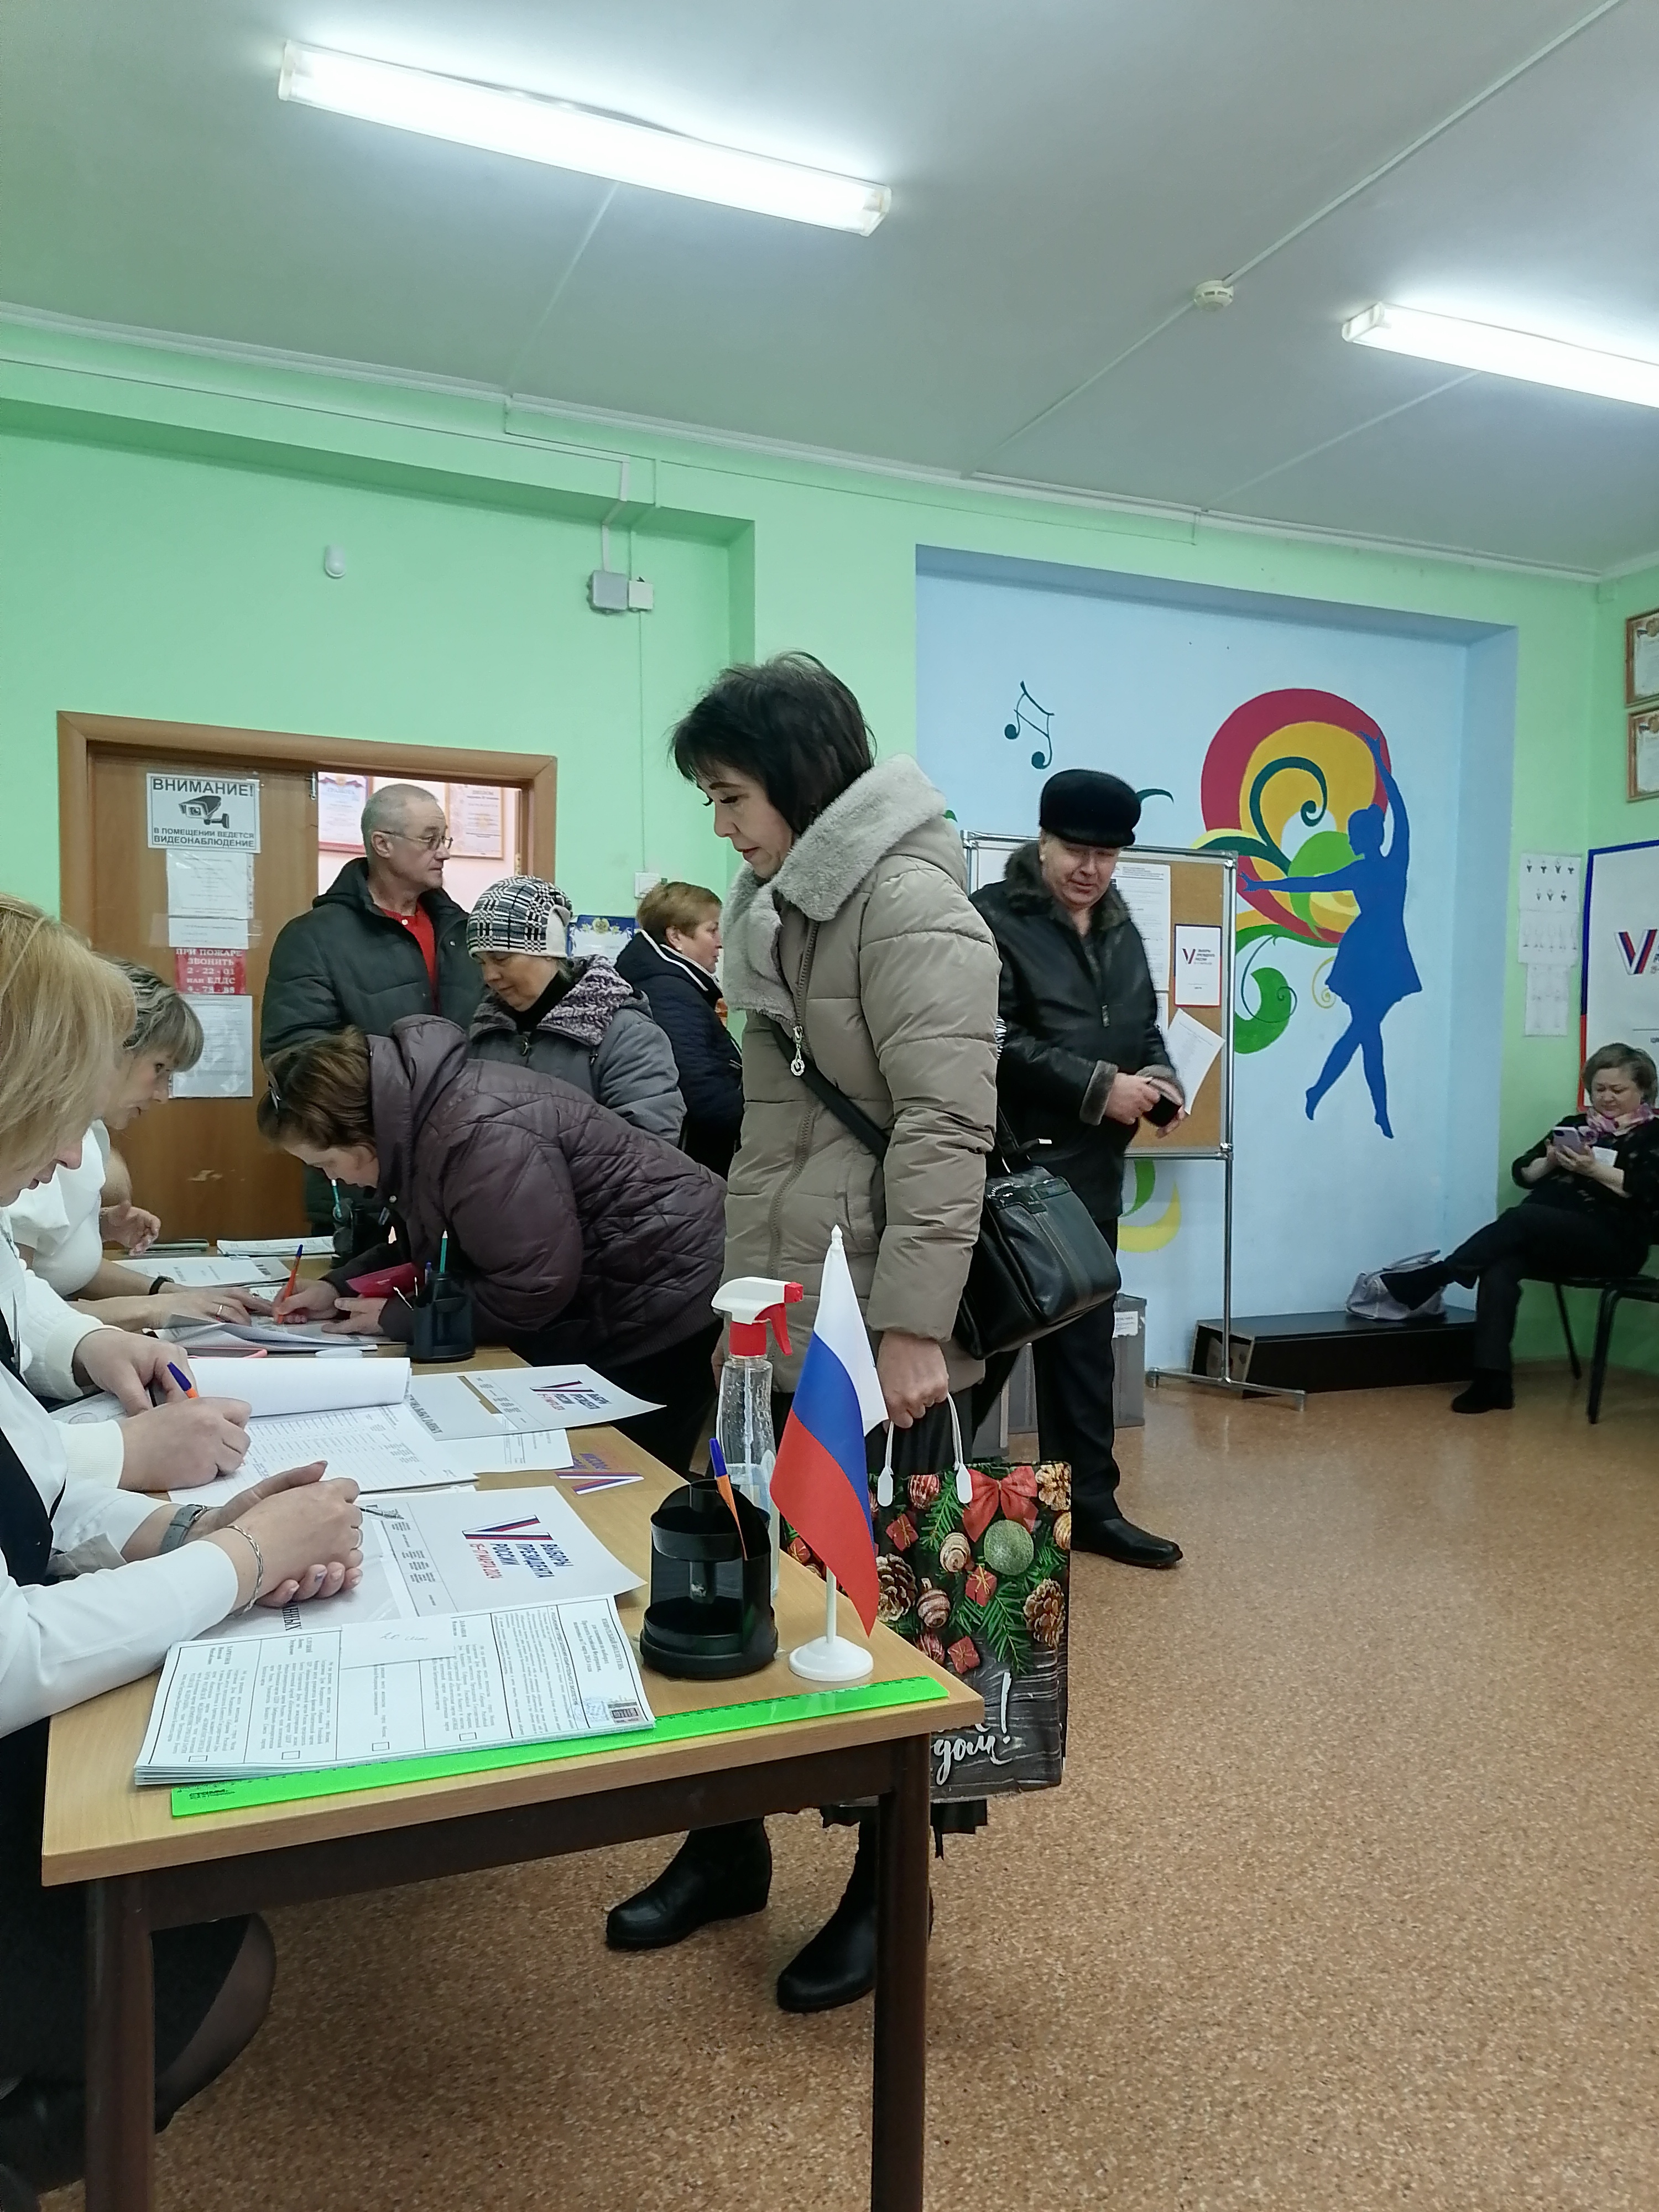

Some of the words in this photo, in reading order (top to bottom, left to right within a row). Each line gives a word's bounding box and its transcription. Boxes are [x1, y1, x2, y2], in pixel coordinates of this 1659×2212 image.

[153, 778, 253, 797] ВНИМАНИЕ!
[154, 835, 254, 848] ВИДЕОНАБЛЮДЕНИЕ
[161, 827, 215, 837] ПОМЕЩЕНИИ
[217, 830, 254, 839] ВЕДЕТСЯ
[200, 949, 243, 957] ПОЖАРЕ
[490, 1543, 520, 1566] РОССИИ
[515, 1543, 555, 1578] ПРЕЗИДЕНТА
[539, 1543, 574, 1567] ВЫБОРЫ
